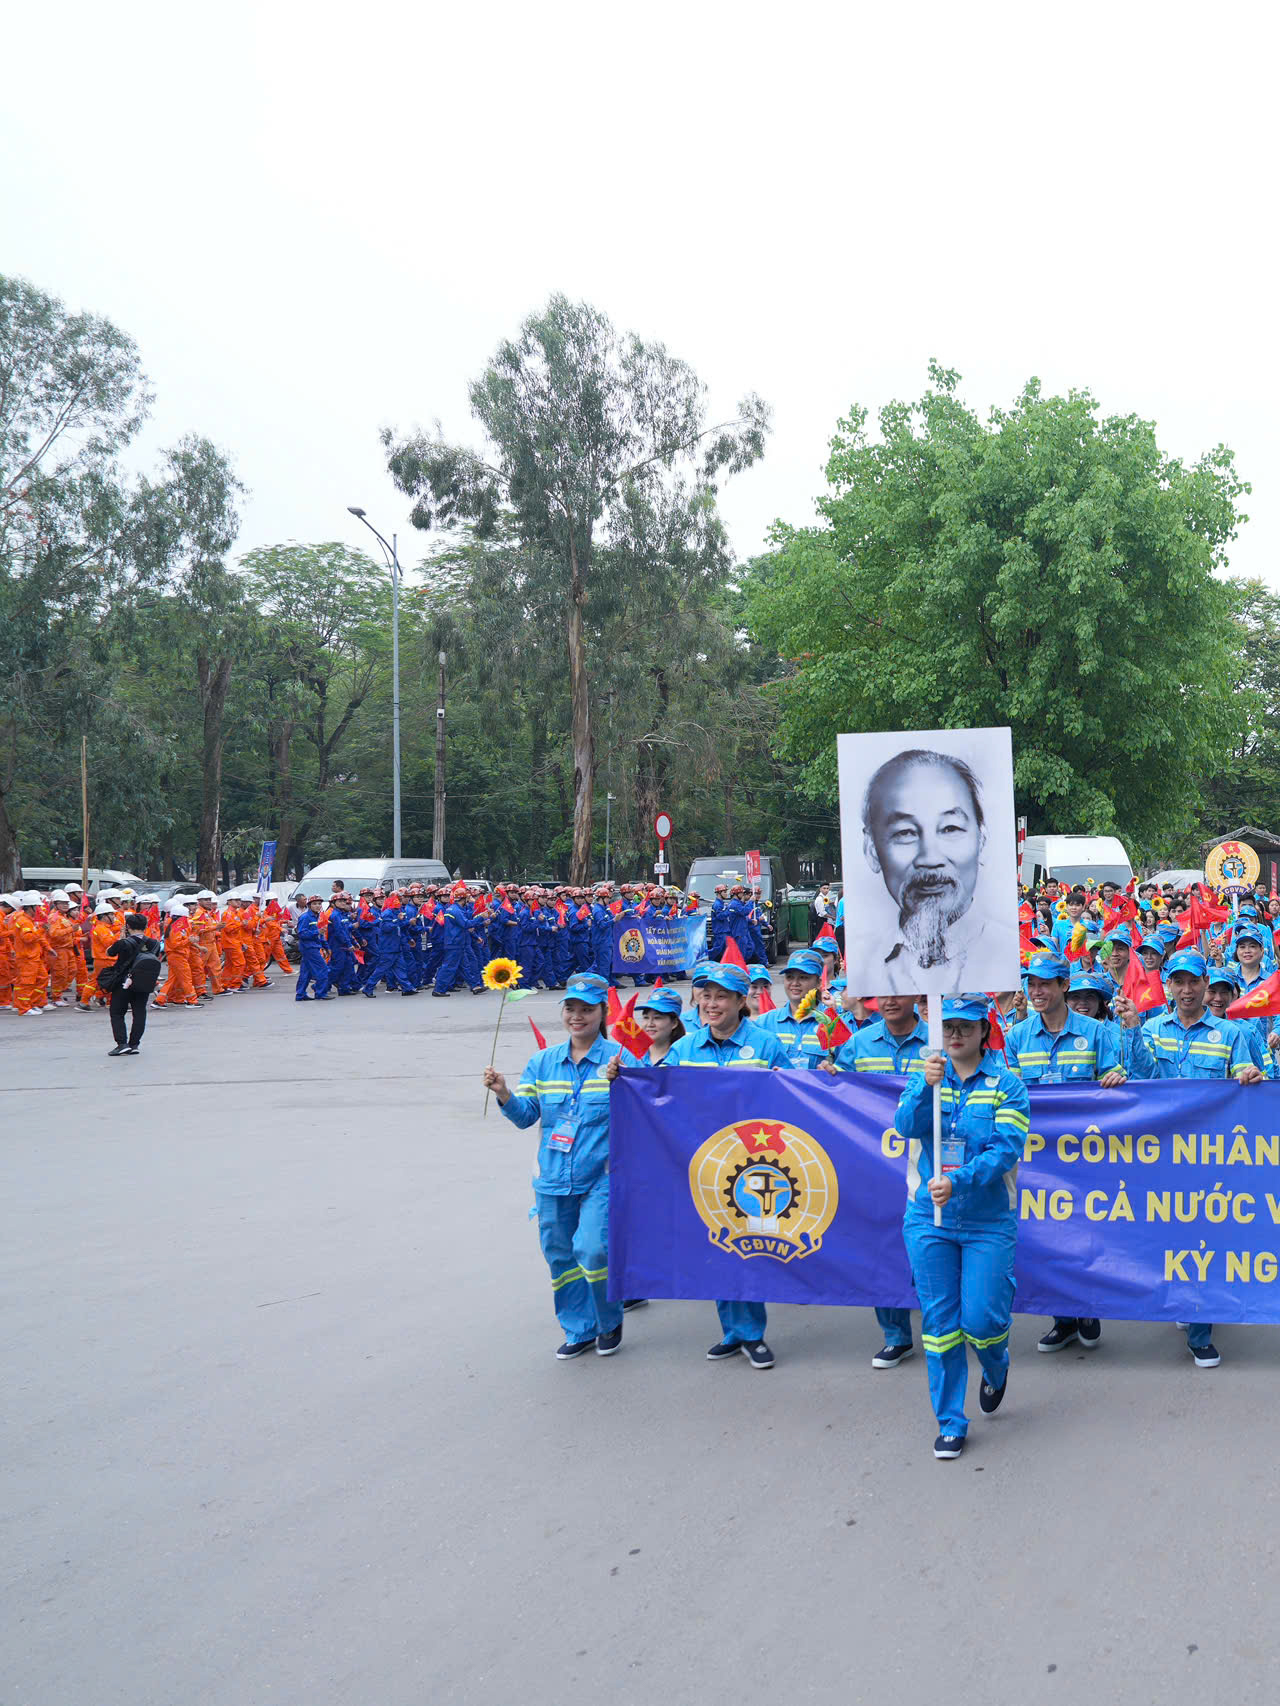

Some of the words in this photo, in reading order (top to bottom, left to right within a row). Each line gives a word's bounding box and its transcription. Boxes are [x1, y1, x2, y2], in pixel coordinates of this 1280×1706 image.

[1057, 1125, 1161, 1164] CÔNG
[1173, 1125, 1280, 1167] NHÂN
[1085, 1180, 1135, 1222] CẢ
[1146, 1182, 1256, 1224] NƯỚC
[740, 1239, 790, 1257] CĐVN
[1164, 1239, 1215, 1282] KỶ
